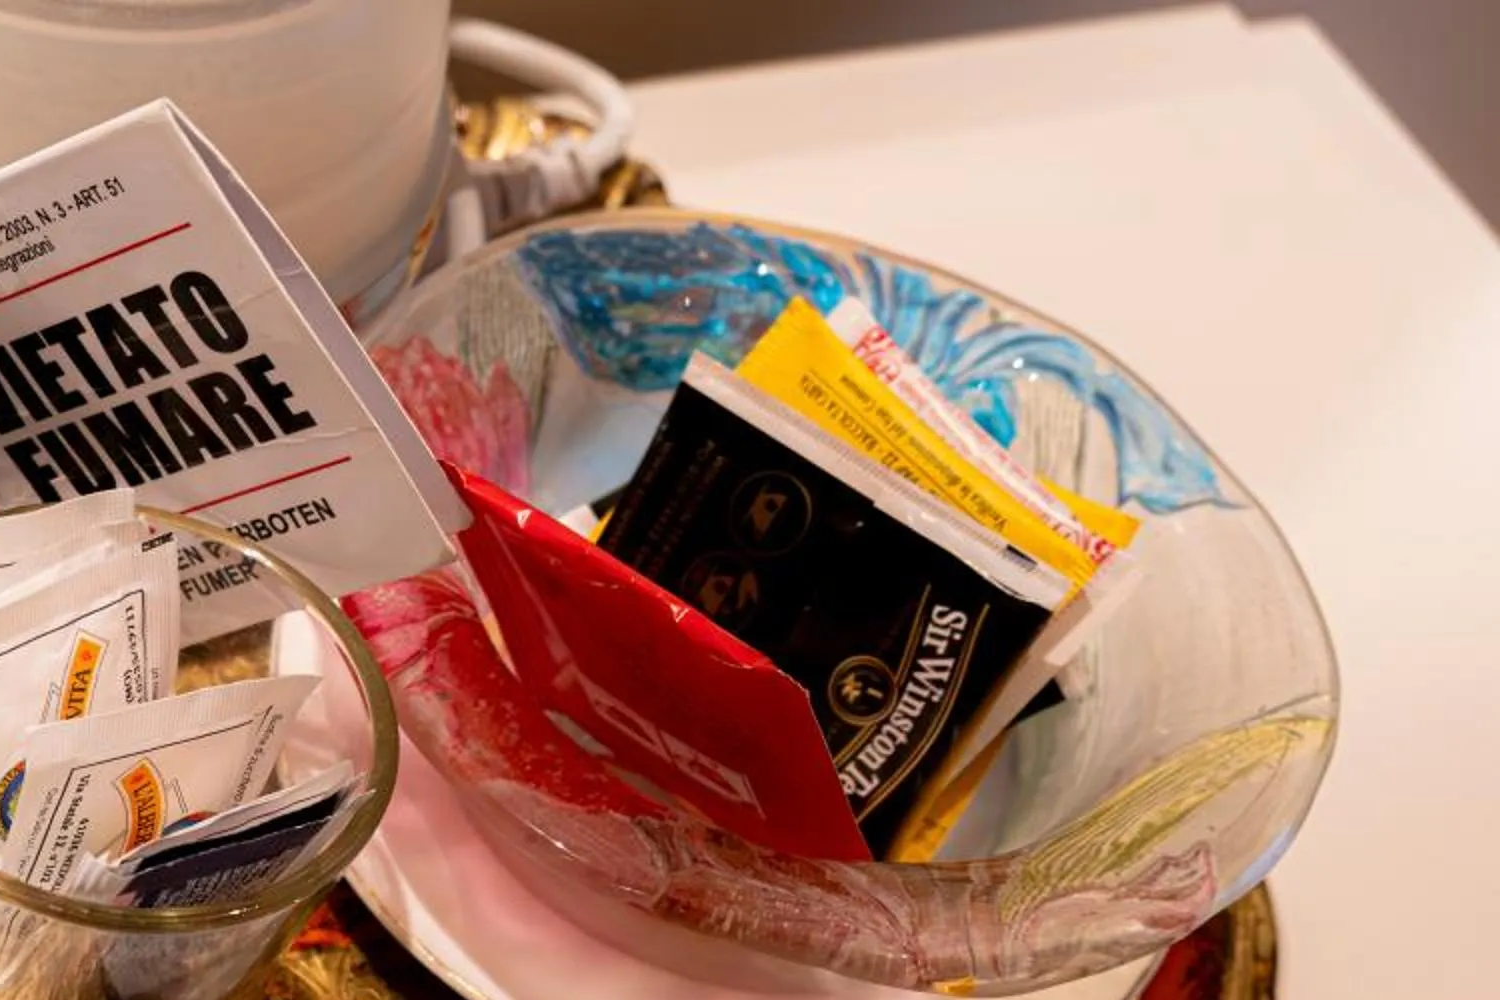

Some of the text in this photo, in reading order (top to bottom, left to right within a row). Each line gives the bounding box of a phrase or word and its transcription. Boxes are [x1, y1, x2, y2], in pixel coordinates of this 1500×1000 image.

[0, 214, 39, 241] 2003,
[52, 201, 67, 218] 3
[71, 185, 106, 210] ART.
[105, 176, 126, 197] 51
[3, 354, 319, 502] FUMARE
[179, 559, 259, 601] FUMER
[838, 603, 968, 798] Sir Winston Te
